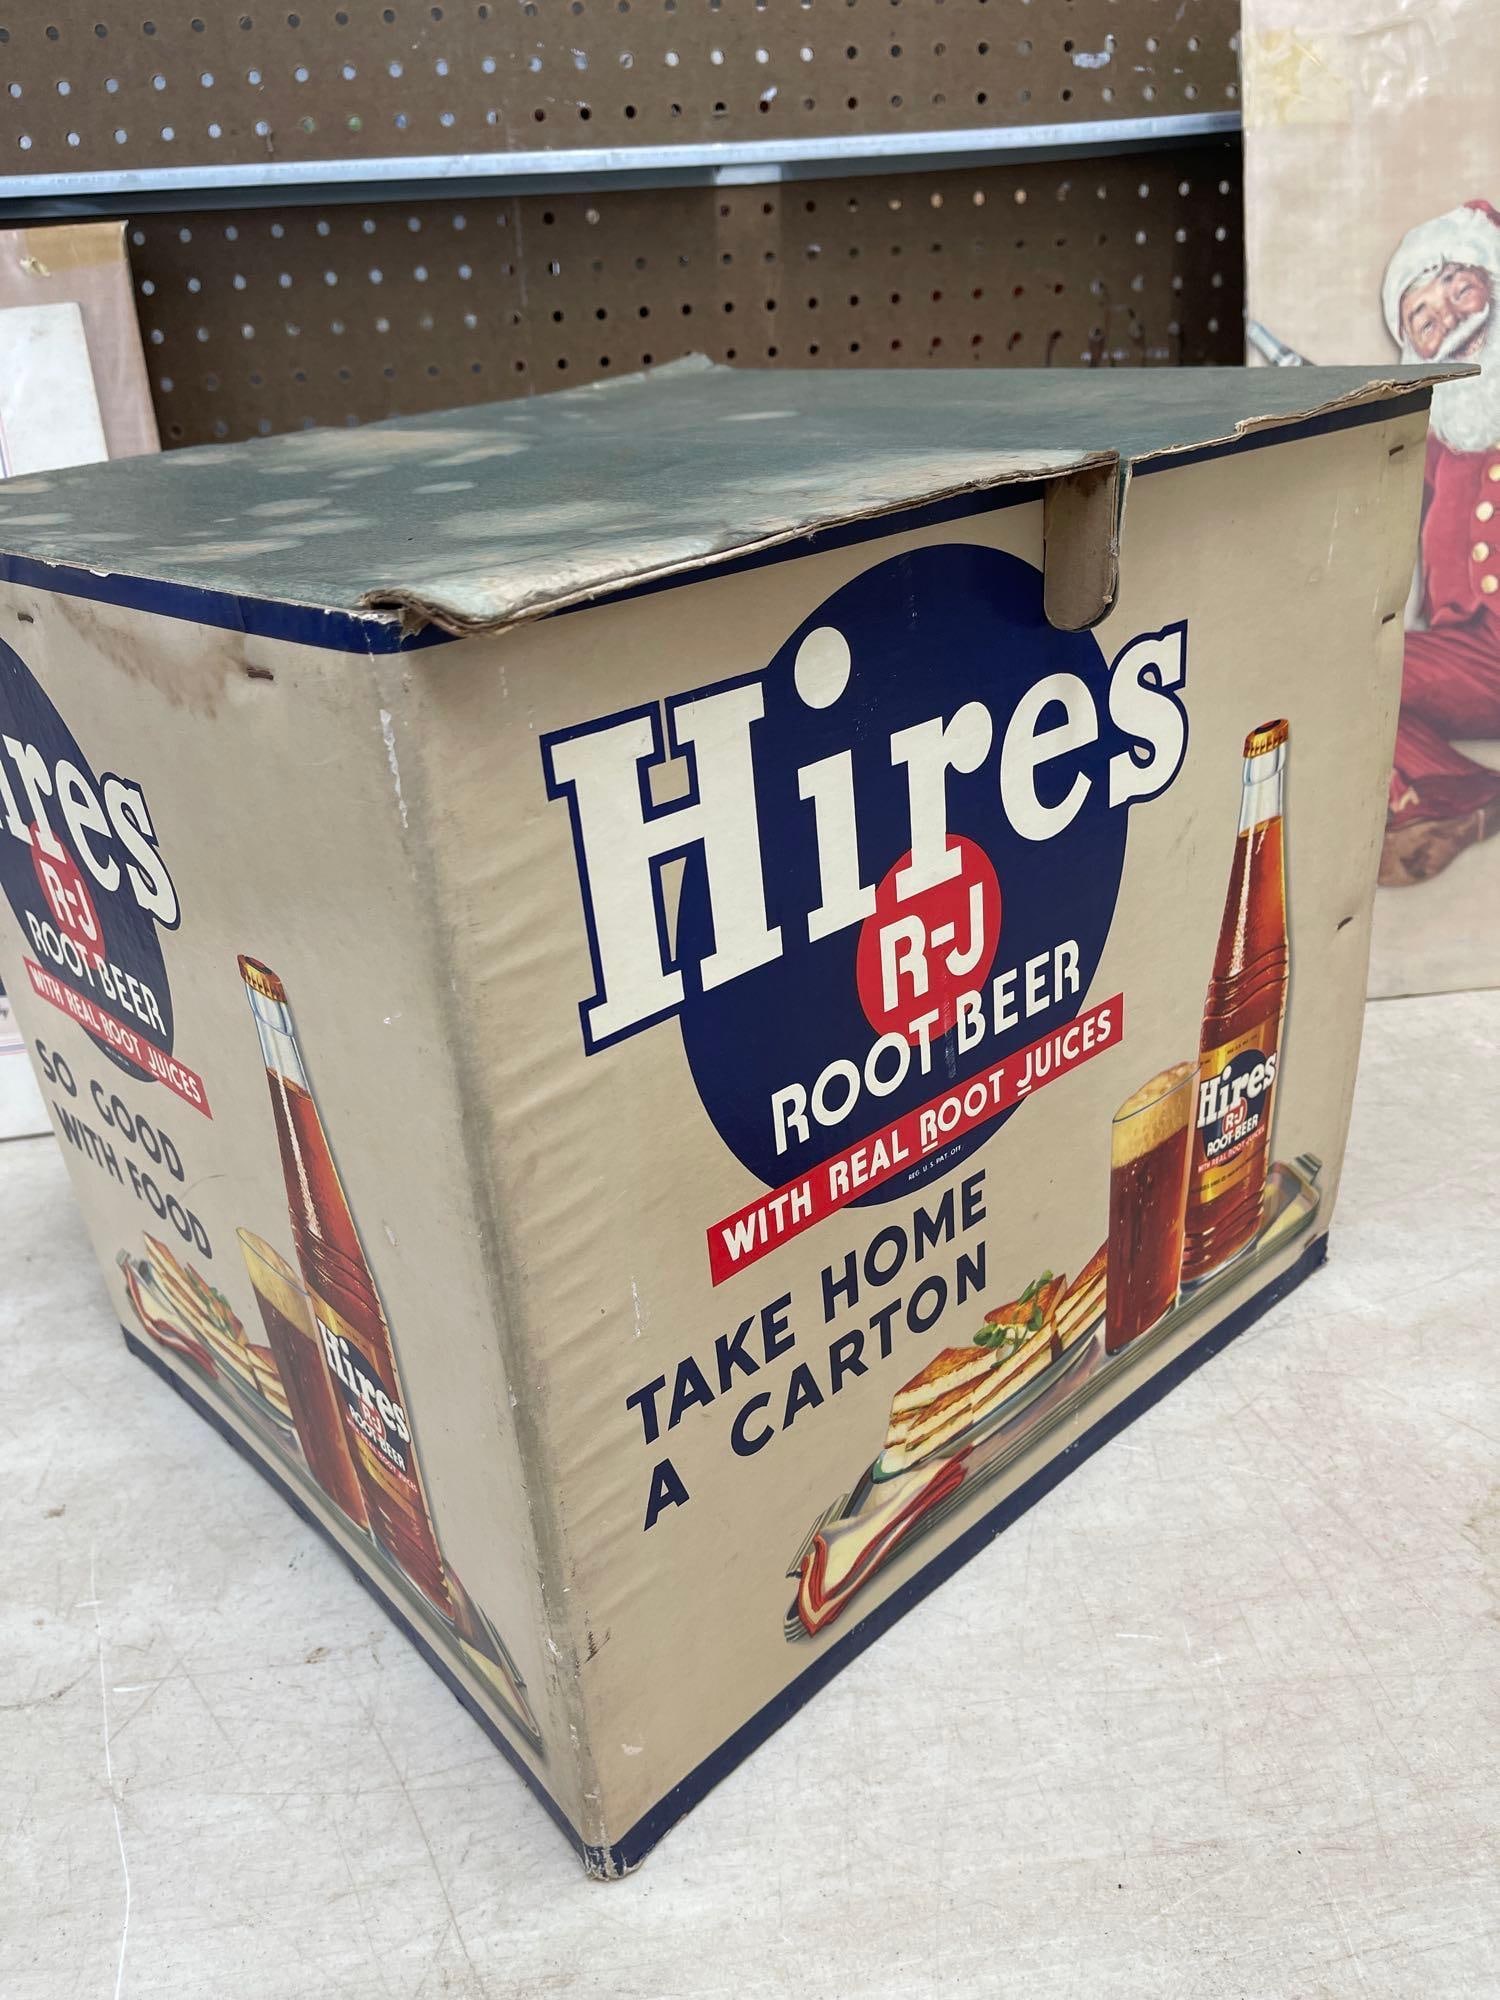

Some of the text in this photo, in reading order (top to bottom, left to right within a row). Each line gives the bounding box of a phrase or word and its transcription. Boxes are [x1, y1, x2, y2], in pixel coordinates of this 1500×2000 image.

[40, 859, 97, 941] R-J
[545, 622, 1186, 1050] Hires
[25, 910, 167, 1037] ROOT BEER
[879, 881, 985, 1013] R-J
[28, 965, 64, 1005] WITH
[64, 989, 101, 1031] REAL
[99, 1012, 142, 1060] ROOT
[147, 1046, 201, 1103] JUICES
[771, 939, 1080, 1155] ROOT BEER
[1196, 1052, 1277, 1128] Hires
[35, 1038, 185, 1182] SO GOOD
[52, 1099, 212, 1260] WITH FOOD
[722, 1009, 1111, 1262] WITH REAL ROOT JUICES
[1207, 1114, 1259, 1157] ROOT BEER
[626, 1169, 986, 1445] TAKE HOME
[317, 1318, 410, 1443] Hires
[643, 1241, 986, 1532] A CARTON
